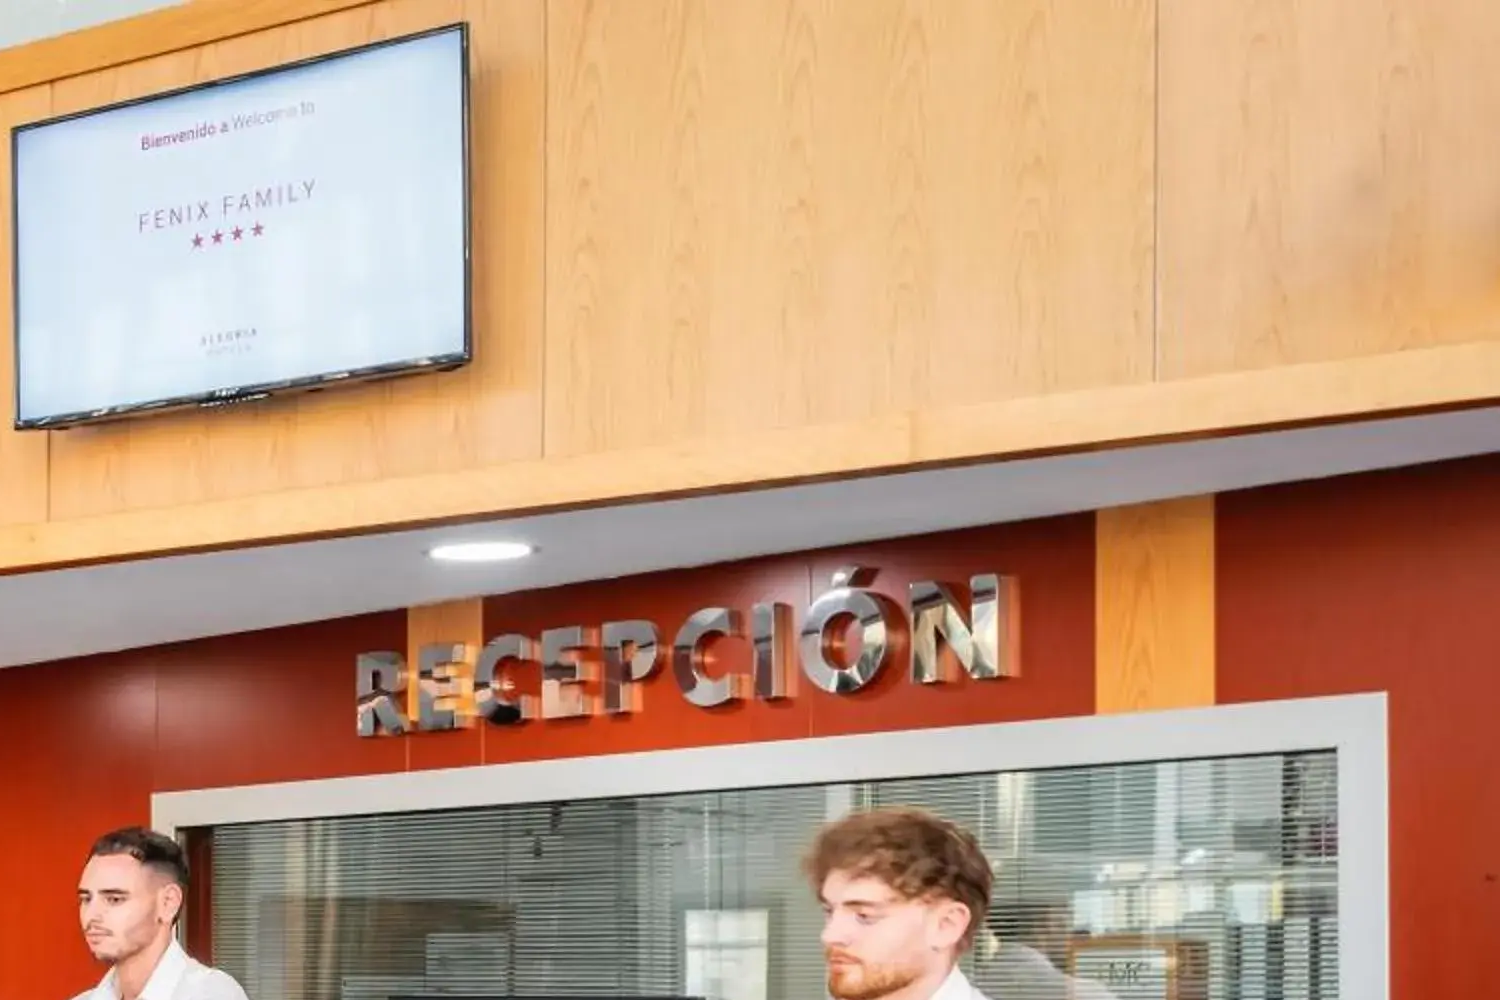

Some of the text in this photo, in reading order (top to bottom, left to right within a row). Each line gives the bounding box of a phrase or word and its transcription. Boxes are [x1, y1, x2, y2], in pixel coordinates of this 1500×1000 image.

[140, 121, 217, 151] Bienvenido
[219, 121, 229, 134] a
[300, 101, 315, 117] to
[138, 179, 316, 233] FENIX FAMILY
[356, 566, 1010, 737] RECEPCIÓN
